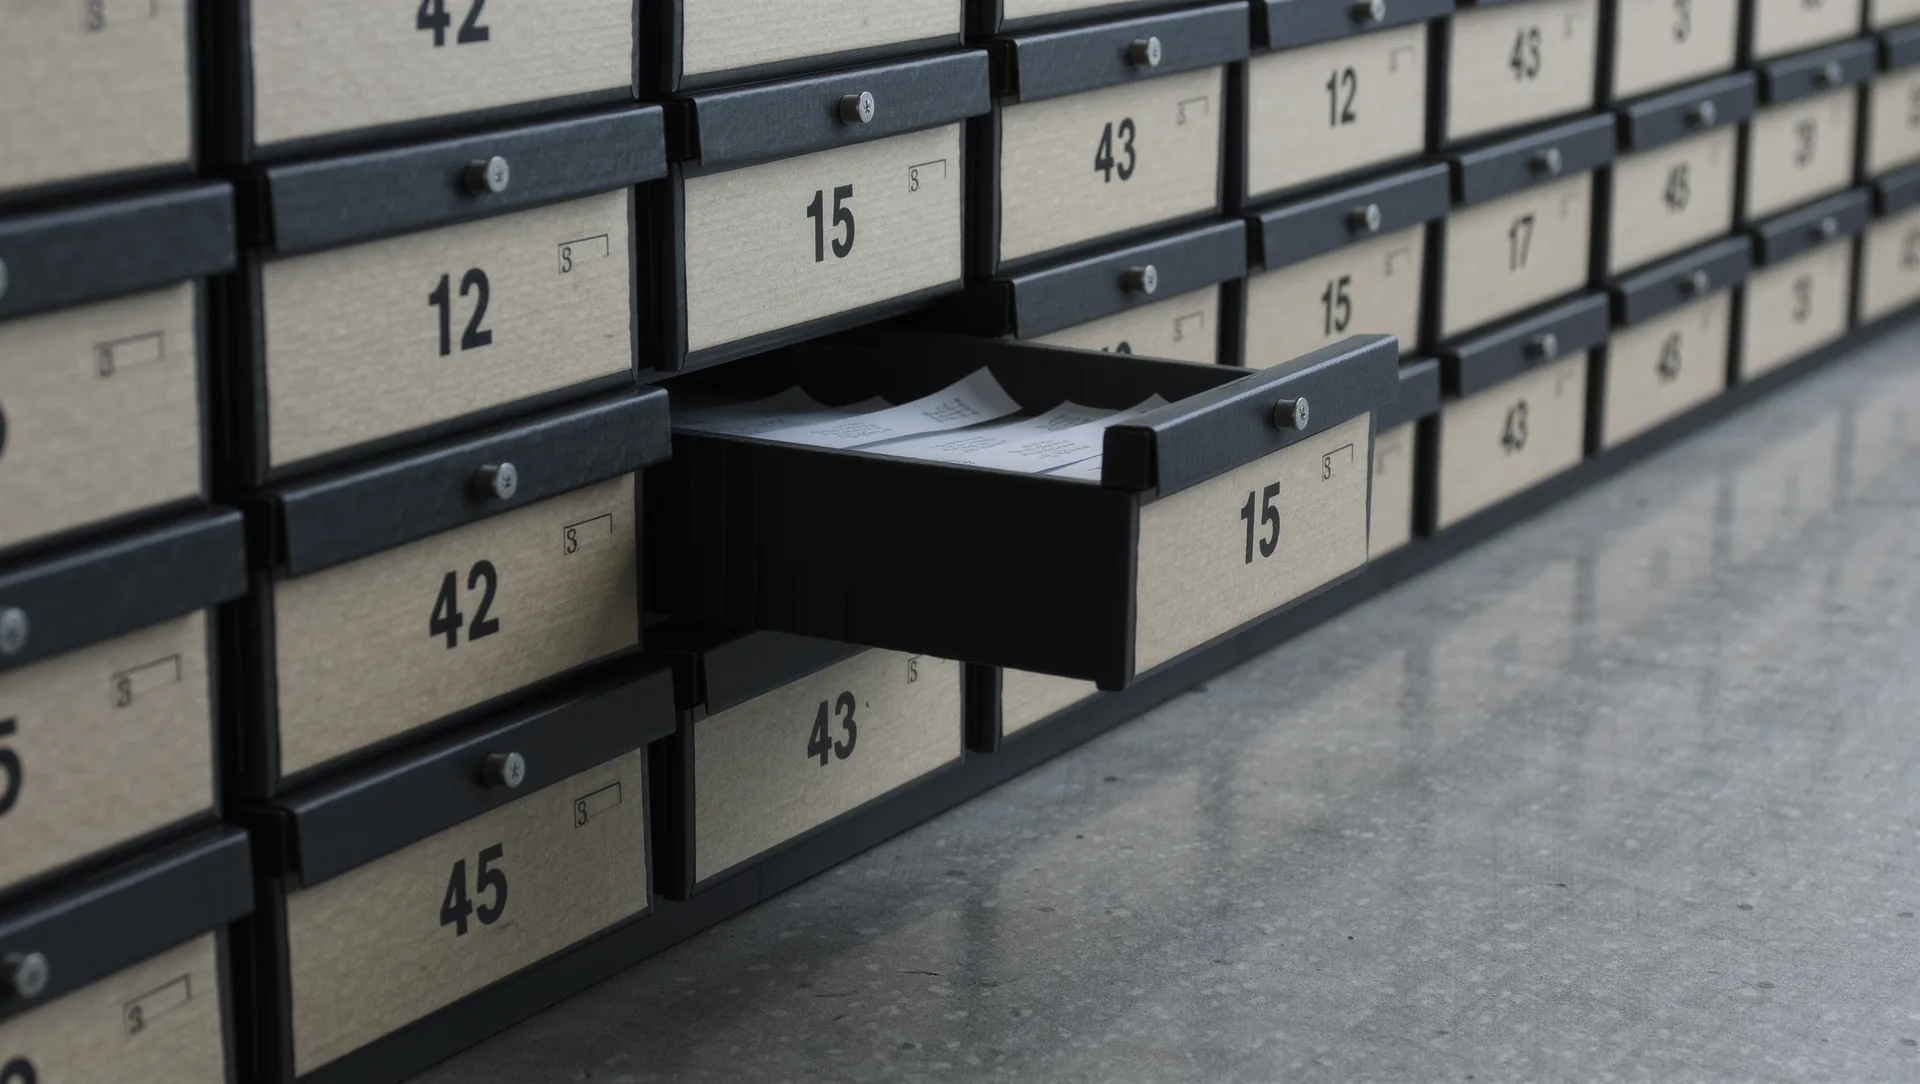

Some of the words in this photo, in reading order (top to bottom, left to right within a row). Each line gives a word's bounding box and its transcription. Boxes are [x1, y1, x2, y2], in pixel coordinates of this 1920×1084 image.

[1326, 67, 1357, 127] 12
[1094, 117, 1136, 184] 43
[806, 183, 856, 263] 15
[428, 267, 493, 357] 12
[1322, 275, 1352, 336] 15
[1240, 481, 1281, 565] 15
[428, 559, 500, 650] 42
[806, 690, 858, 768] 43
[439, 841, 509, 938] 45
